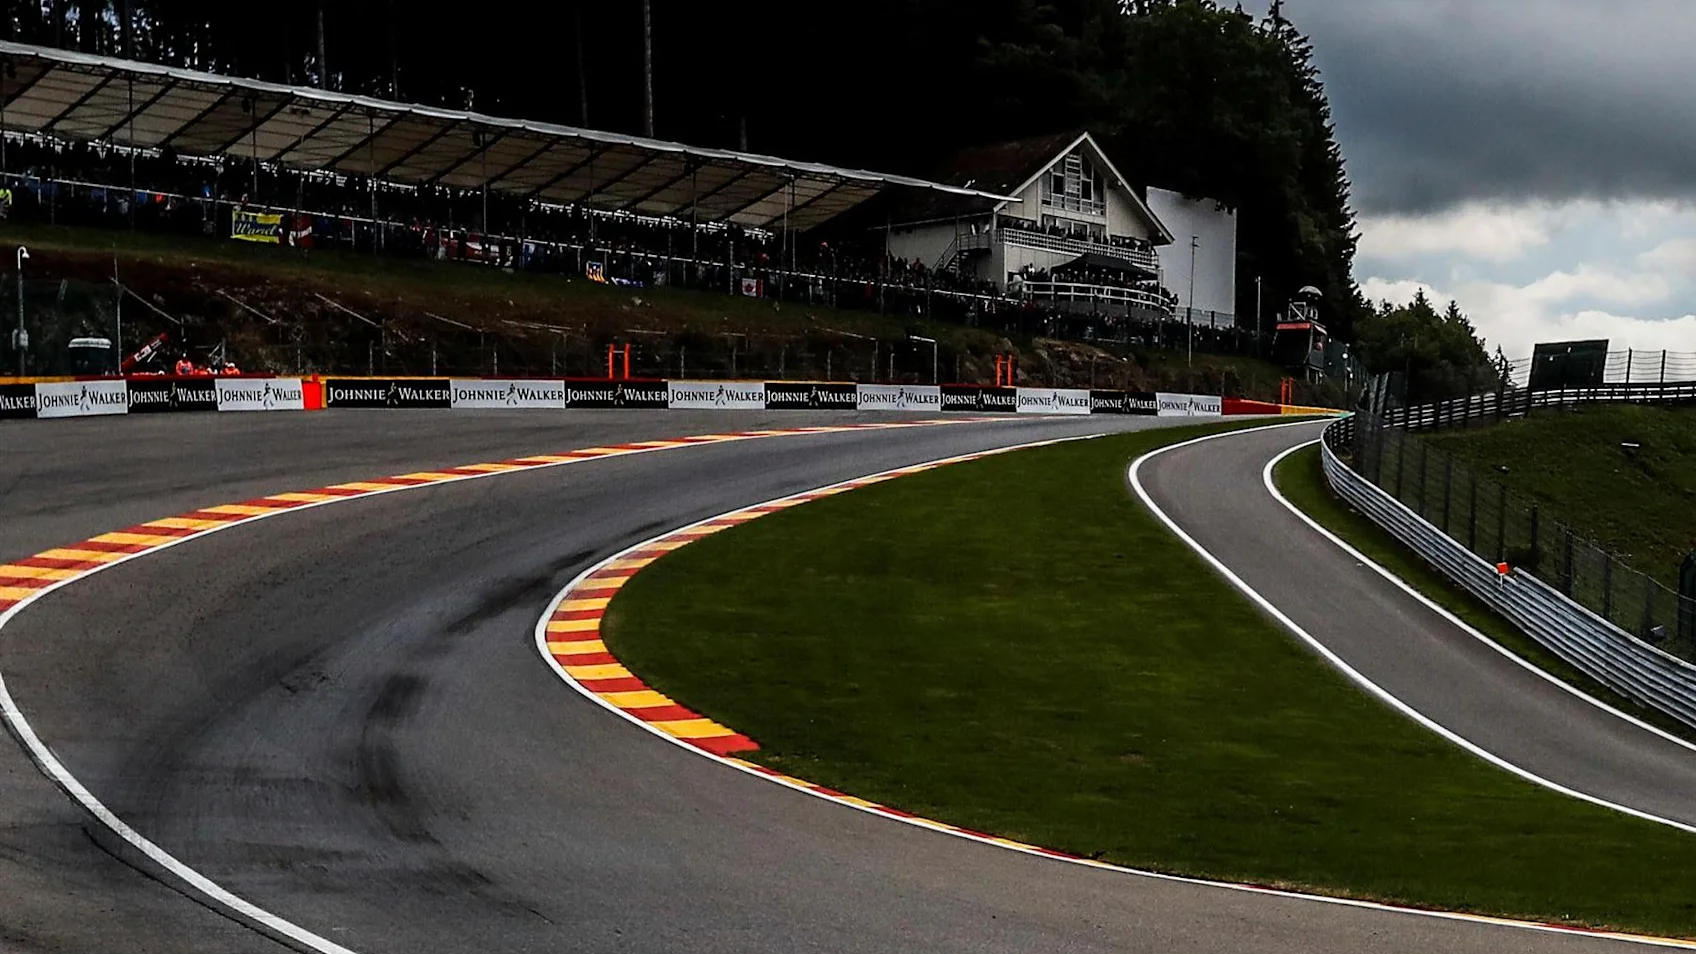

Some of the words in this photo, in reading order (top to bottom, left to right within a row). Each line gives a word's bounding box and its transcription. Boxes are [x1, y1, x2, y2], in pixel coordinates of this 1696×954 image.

[38, 393, 79, 412] JOHNNIE
[88, 391, 126, 405] WALKER
[129, 389, 169, 407] JOHNNIE
[177, 388, 217, 403] WALKER
[219, 387, 262, 405] JOHNNIE
[272, 387, 302, 401] WALKER
[328, 386, 386, 403] JOHNNIE
[398, 387, 451, 401] WALKER
[453, 388, 506, 404] JOHNNIE
[517, 388, 564, 401] WALKER
[566, 388, 614, 404] JOHNNIE
[624, 388, 668, 401] WALKER
[670, 389, 715, 404] JOHNNIE
[725, 389, 764, 402] WALKER
[766, 389, 809, 404] JOHNNIE
[818, 390, 857, 403] WALKER
[858, 391, 897, 405] JOHNNIE
[905, 392, 939, 404] WALKER
[941, 393, 976, 407] JOHNNIE
[982, 394, 1016, 406] WALKER
[1017, 394, 1052, 407] JOHNNIE
[1057, 395, 1089, 407] WALKER
[1090, 397, 1122, 410] JOHNNIE
[1129, 398, 1157, 409] WALKER
[1158, 399, 1188, 411] JOHNNIE
[1193, 400, 1221, 413] WALKER
